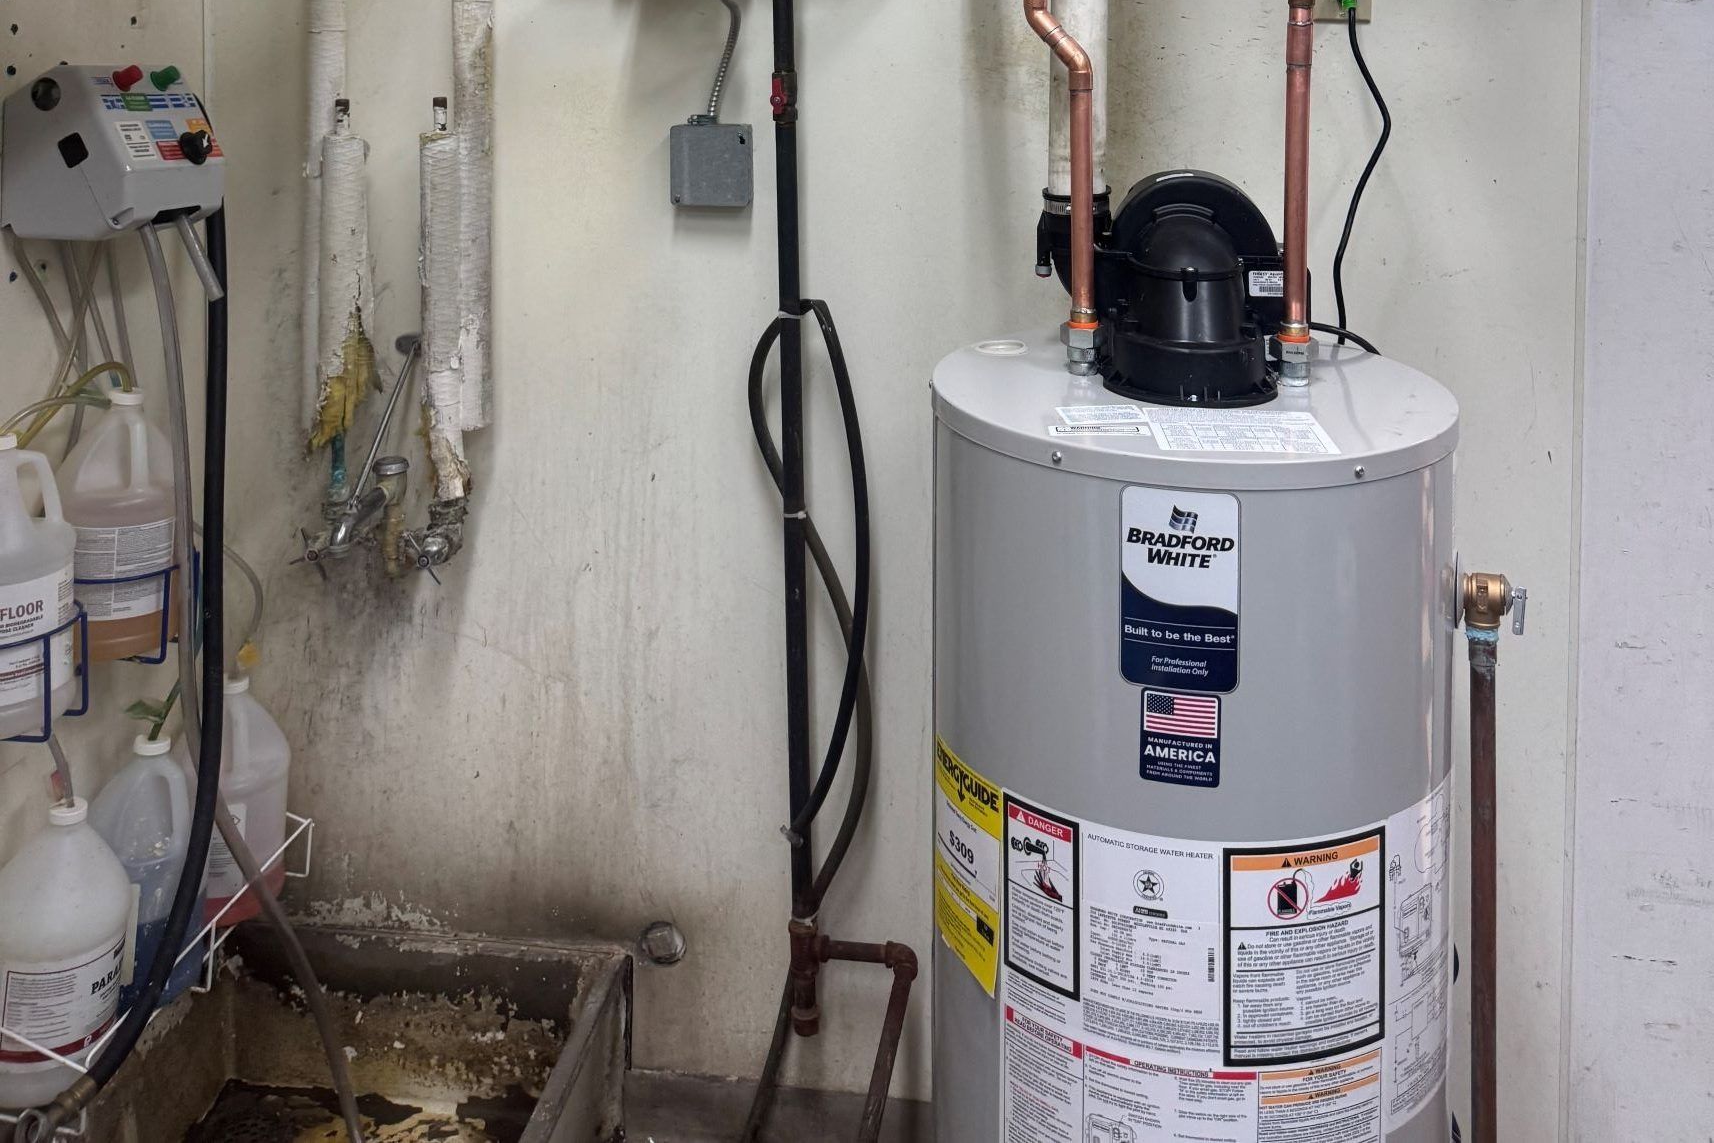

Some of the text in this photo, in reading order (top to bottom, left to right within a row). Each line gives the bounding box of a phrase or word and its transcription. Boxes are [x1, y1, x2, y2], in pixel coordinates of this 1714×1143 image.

[1127, 527, 1234, 551] BRADFORD
[1147, 547, 1211, 568] WHITE
[0, 600, 43, 621] FLOOR
[1124, 624, 1148, 637] Built
[1151, 629, 1162, 638] to
[1165, 630, 1180, 640] be
[1183, 632, 1201, 642] the
[1151, 655, 1207, 668] For Professional
[1151, 663, 1208, 677] Installation Only
[1147, 736, 1203, 748] MANUFACTURED
[1144, 744, 1216, 763] AMERICA
[1028, 817, 1063, 837] DANGER
[949, 830, 974, 864] $309
[1087, 833, 1214, 859] AUTOMATIC STORAGE WATER HEATER
[1294, 851, 1338, 866] WARNING
[1294, 926, 1325, 934] EXPLOSION
[1327, 919, 1349, 928] HAZARD
[1133, 1060, 1209, 1078] OPERATING INSTRUCTIONS
[1315, 1065, 1341, 1074] WARNING
[1329, 1069, 1347, 1077] SAFETY
[1315, 1088, 1341, 1098] WARNING
